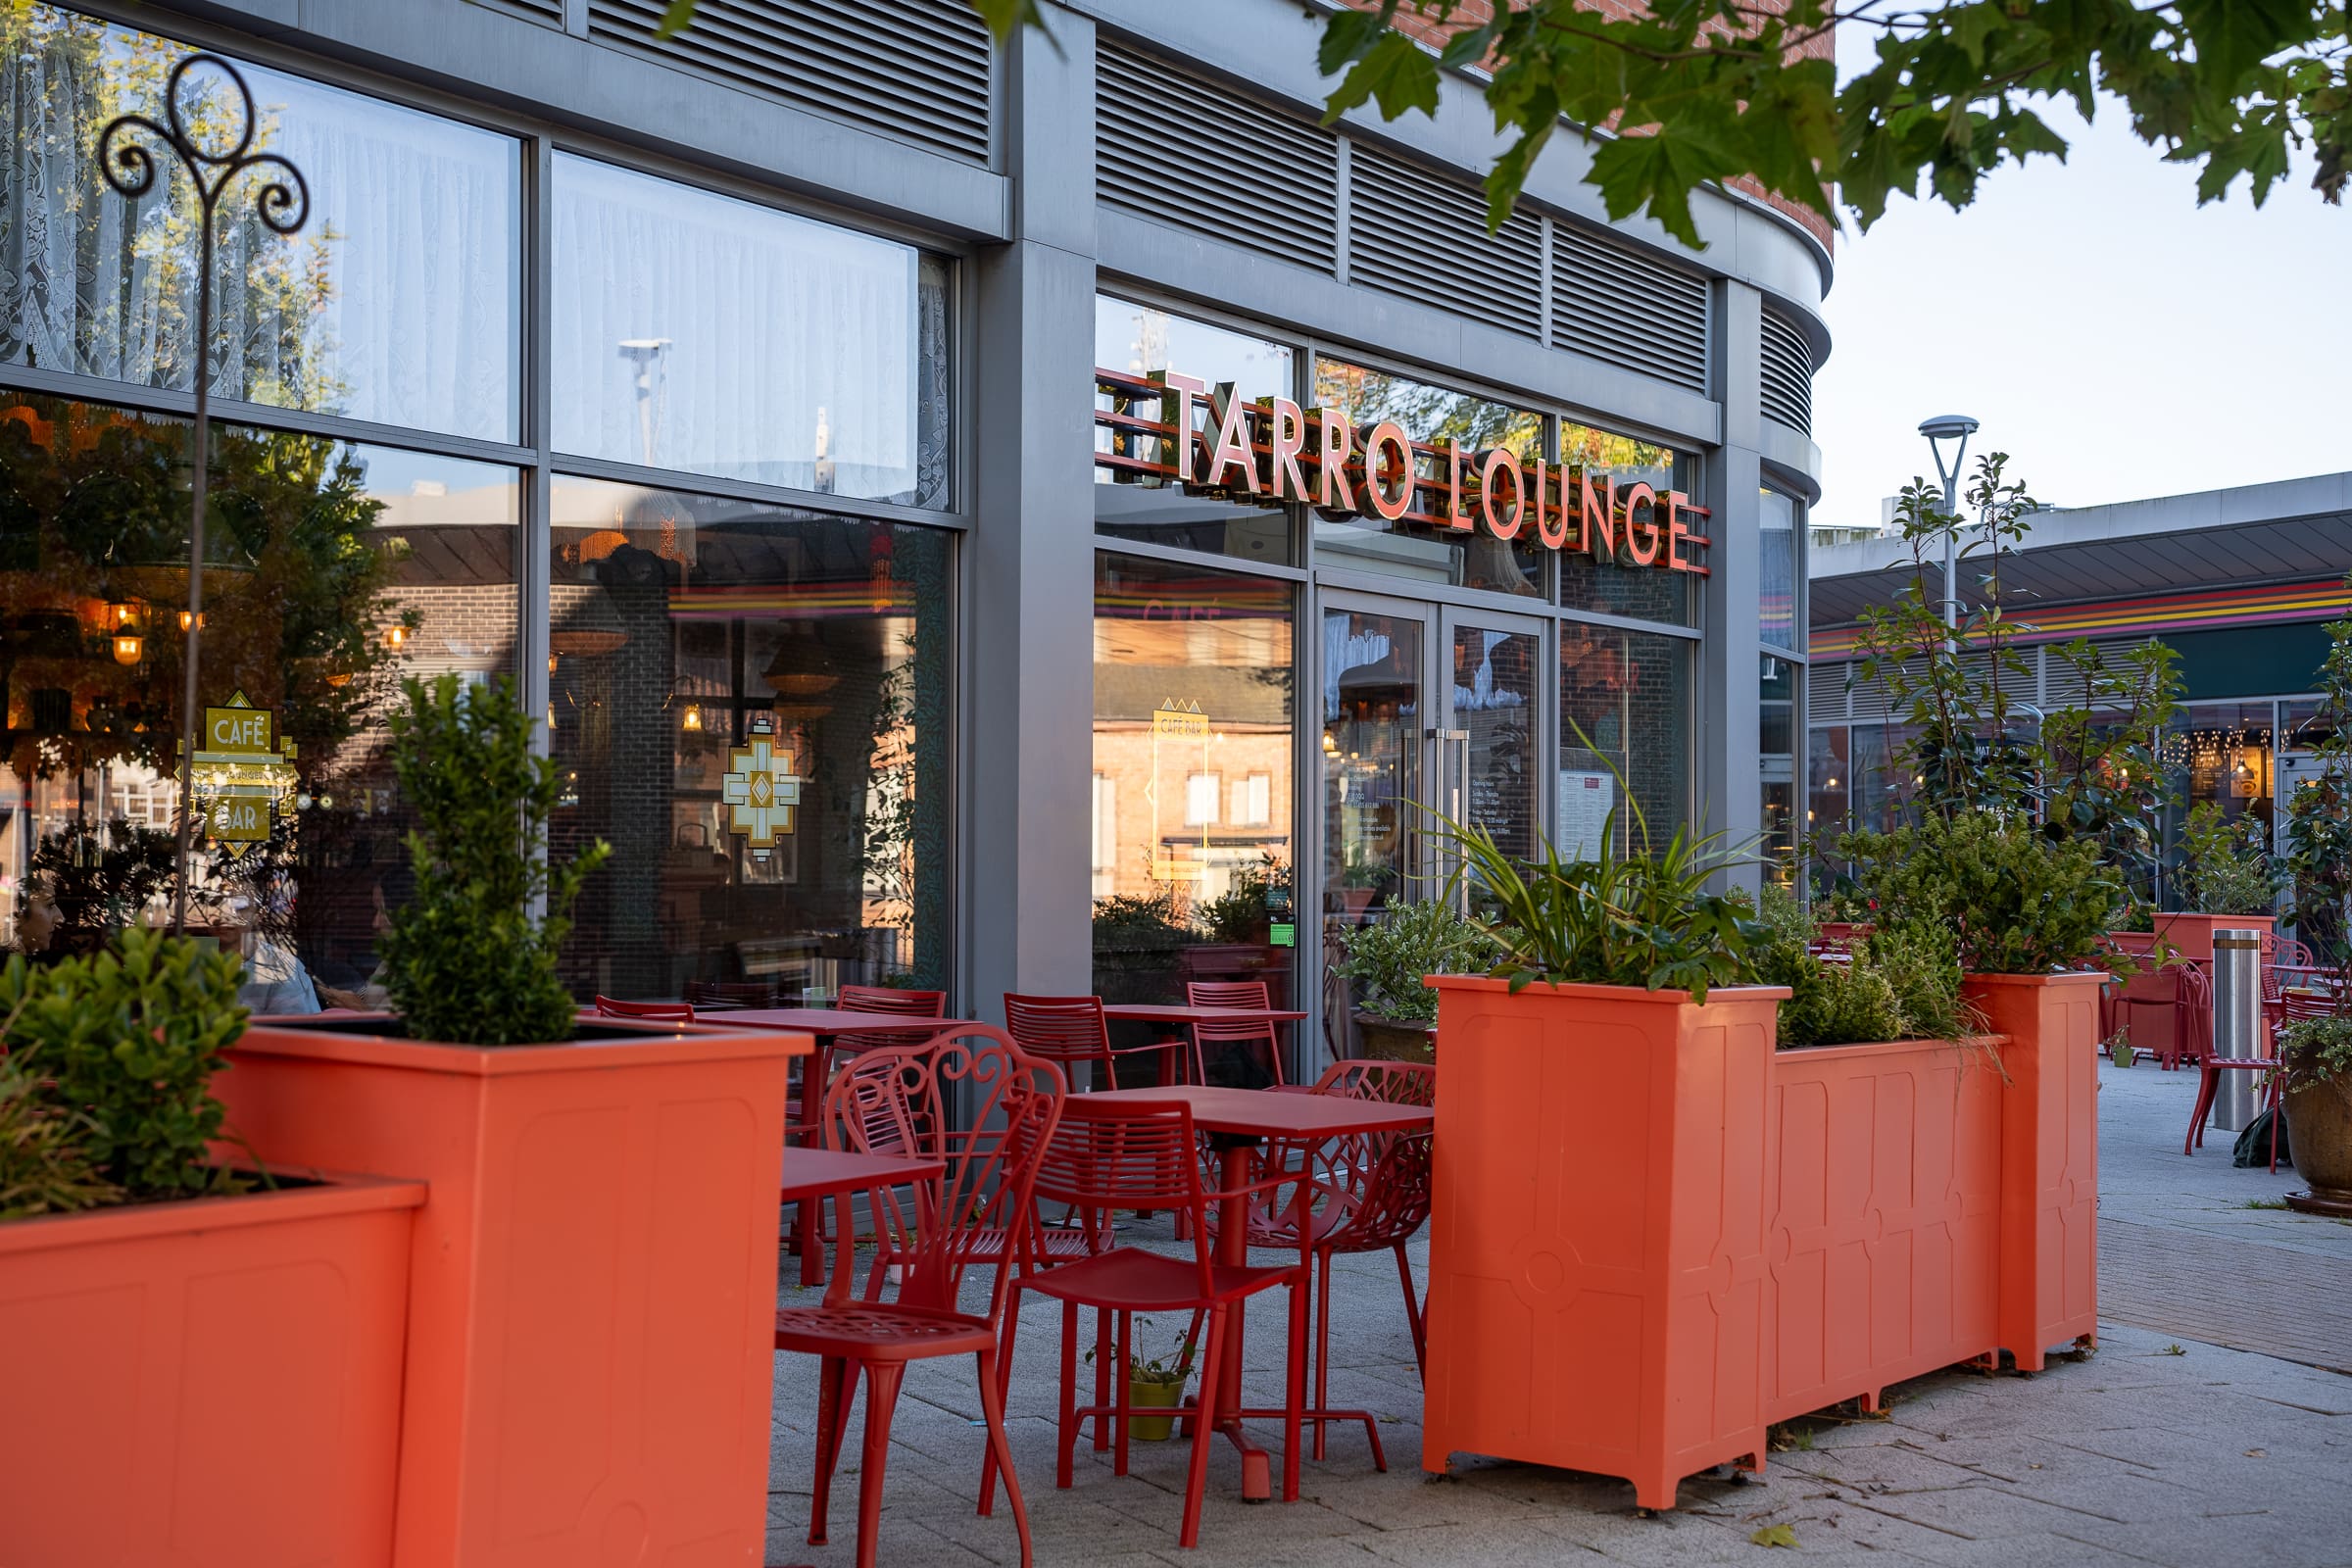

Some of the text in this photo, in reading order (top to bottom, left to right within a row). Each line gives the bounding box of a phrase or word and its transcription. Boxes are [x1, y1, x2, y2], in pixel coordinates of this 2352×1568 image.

[1164, 369, 1690, 571] TARRO LOUNGE
[214, 715, 265, 746] CAFÉ
[1160, 716, 1201, 737] CAFÉ BAR
